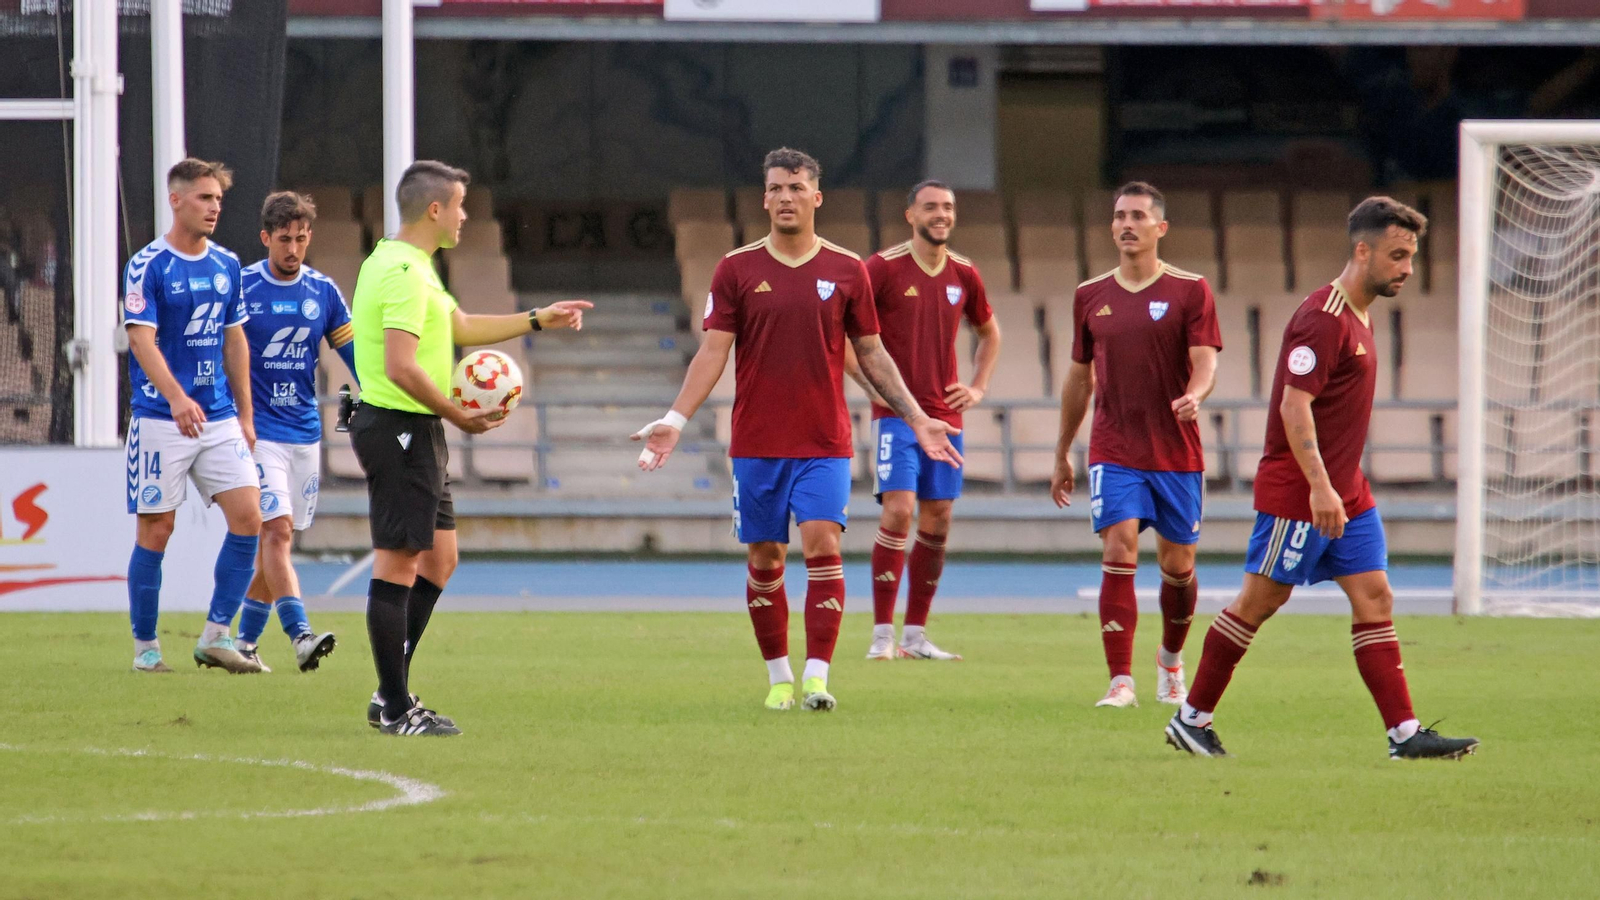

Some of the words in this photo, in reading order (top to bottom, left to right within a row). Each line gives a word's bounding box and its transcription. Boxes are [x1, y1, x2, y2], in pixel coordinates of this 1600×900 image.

[203, 319, 222, 335] Ar
[283, 343, 308, 358] Air
[264, 360, 305, 370] oneair.es
[879, 433, 892, 460] 5
[144, 451, 162, 480] 14
[1290, 520, 1310, 549] 8
